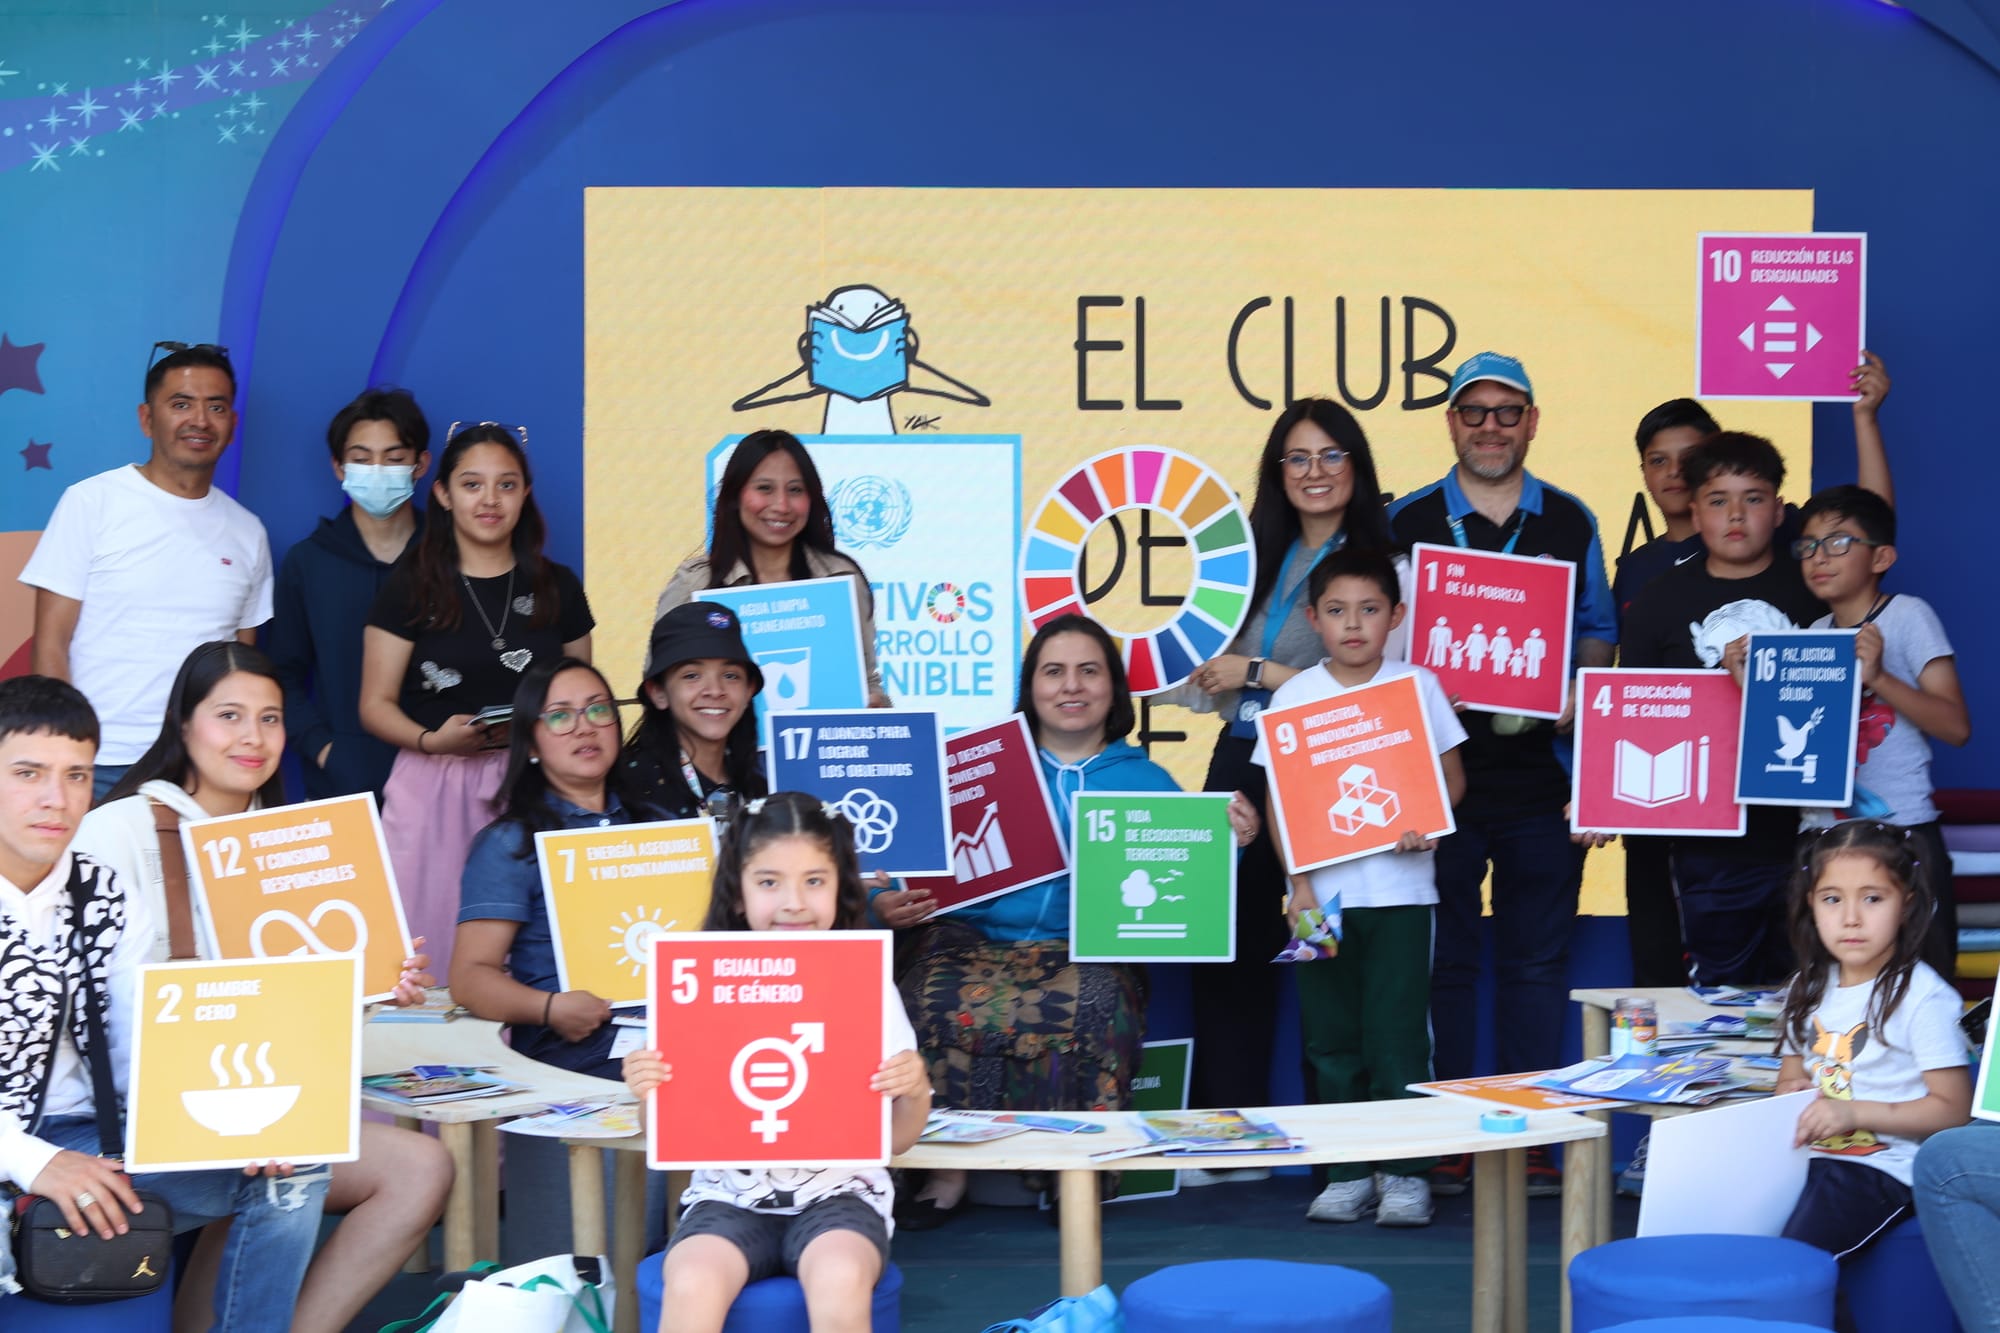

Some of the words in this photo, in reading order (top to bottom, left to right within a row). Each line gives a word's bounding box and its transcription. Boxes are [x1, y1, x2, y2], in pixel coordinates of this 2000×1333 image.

[1709, 249, 1742, 283] 10
[1751, 246, 1814, 264] REDUCCIÓN
[1816, 250, 1832, 264] DE
[1832, 250, 1854, 264] LAS
[1751, 269, 1839, 283] DESIGUALDADES
[1074, 296, 1182, 411] EL
[1228, 296, 1457, 411] CLUB
[1424, 561, 1439, 592] 1
[1446, 563, 1466, 578] FIN
[1445, 581, 1461, 595] DE
[1461, 582, 1476, 597] LA
[1476, 584, 1527, 604] POBREZA
[739, 602, 769, 617] AGUA
[769, 598, 810, 614] LIMPIA
[750, 614, 826, 635] SANEAMIENTO
[1754, 647, 1777, 682] 16
[1800, 647, 1836, 662] JUSTICIA
[1780, 667, 1788, 681] E
[1786, 667, 1847, 682] INSTITUCIONES
[1592, 685, 1613, 717] 4
[1623, 682, 1692, 699] EDUCACIÓN
[1779, 683, 1814, 701] SÓLIDAS
[1622, 704, 1639, 718] DE
[1640, 704, 1691, 718] CALIDAD
[779, 727, 813, 760] 17
[817, 726, 876, 740] ALIANZAS
[876, 725, 912, 739] PARA
[1275, 722, 1298, 755] 9
[1306, 718, 1374, 749] INNOVACIÓN
[1374, 716, 1384, 731] E
[818, 745, 870, 760] LOGRAR
[957, 738, 1005, 764] DECENTE
[1310, 729, 1413, 767] INFRAESTRUCTURA
[819, 764, 845, 778] LOS
[846, 763, 914, 778] OBJETIVOS
[1085, 809, 1116, 843] 15
[1125, 810, 1152, 823] VIDA
[248, 817, 333, 848] PRODUCCIÓN
[1125, 829, 1140, 843] DE
[1141, 829, 1213, 843] ECOSISTEMAS
[202, 836, 247, 879] 12
[253, 855, 266, 872] Y
[265, 844, 330, 870] CONSUMO
[586, 840, 637, 861] ENERGÍA
[638, 837, 701, 856] ASEQUIBLE
[1125, 848, 1190, 862] TERRESTRES
[557, 848, 576, 883] 7
[589, 867, 599, 881] Y
[601, 865, 619, 880] NO
[620, 856, 710, 879] CONTAMINANTE
[260, 863, 357, 895] RESPONSABLES
[713, 957, 796, 977] IGUALDAD
[196, 979, 263, 998] HAMBRE
[671, 958, 699, 1004] 5
[713, 985, 736, 1004] DE
[738, 979, 803, 1004] GÉNERO
[155, 983, 183, 1023] 2
[195, 1003, 237, 1021] CERO
